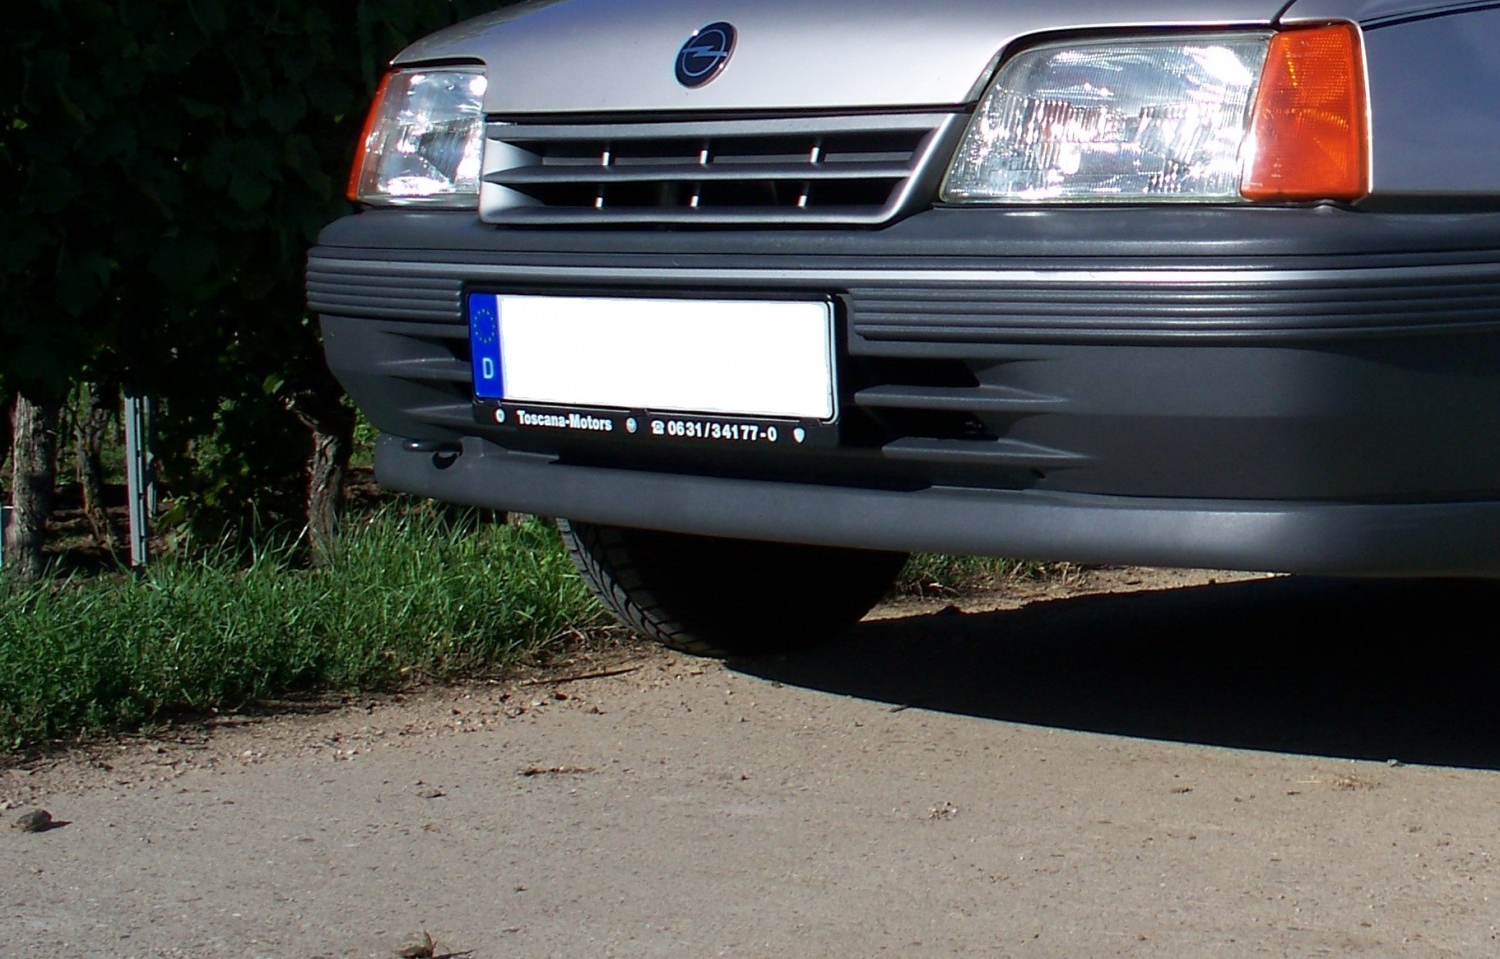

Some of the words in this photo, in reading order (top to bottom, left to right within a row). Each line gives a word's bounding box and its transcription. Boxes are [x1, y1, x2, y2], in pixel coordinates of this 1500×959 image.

[482, 357, 495, 379] D
[516, 410, 613, 431] Toscana-Motors
[667, 420, 778, 442] 0631/34177-0
